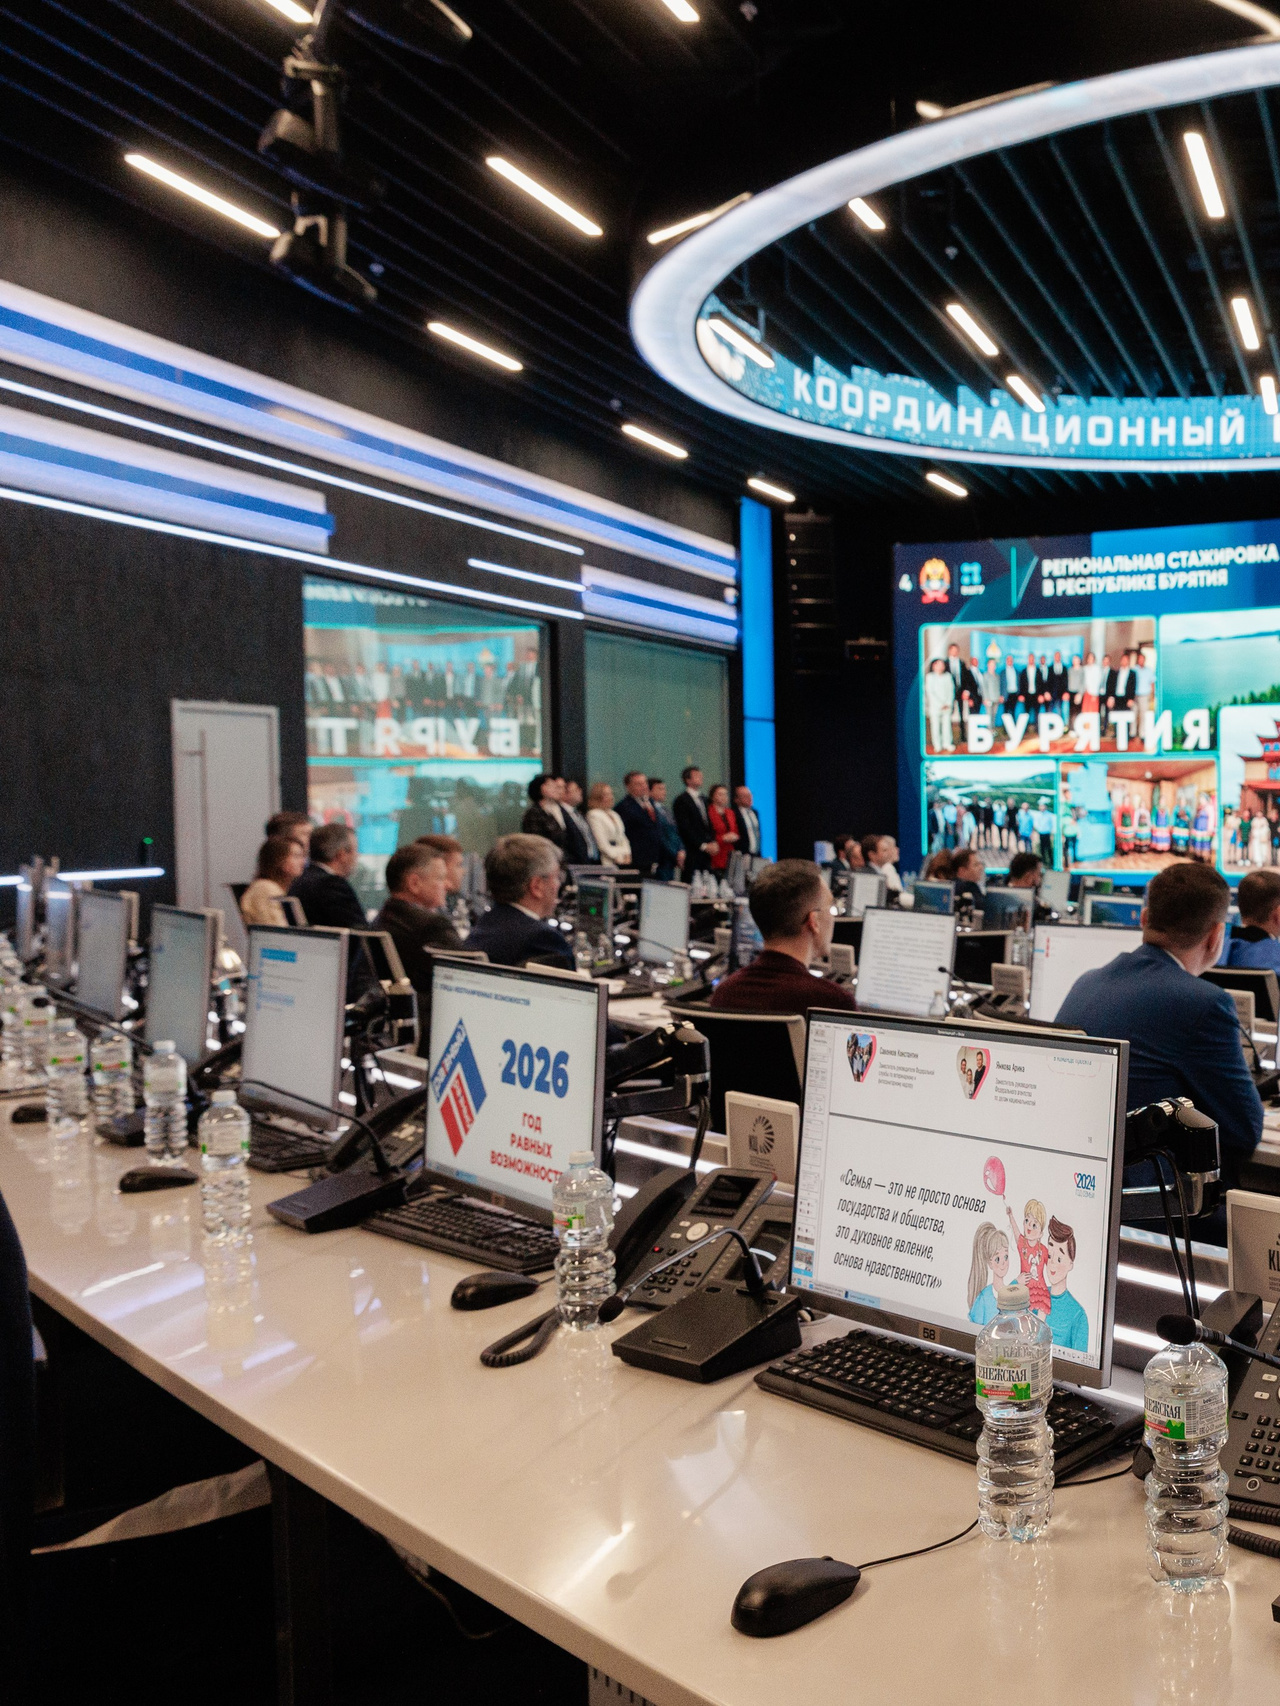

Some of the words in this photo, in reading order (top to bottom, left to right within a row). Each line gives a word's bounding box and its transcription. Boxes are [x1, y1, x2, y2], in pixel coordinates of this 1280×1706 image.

[792, 367, 1246, 447] КООРДИНАЦИОННЫЙ
[1042, 552, 1165, 577] РЕГИОНАЛЬНАЯ
[1167, 543, 1280, 569] СТАЖИРОВКА
[1042, 579, 1054, 597] В
[1056, 572, 1155, 596] РЕСПУБЛИКЕ
[1158, 568, 1228, 590] БУРЯТИЯ
[967, 708, 1212, 755] БУРЯТИЯ
[501, 1039, 569, 1098] 2026
[522, 1112, 542, 1133] ГОД
[510, 1133, 553, 1159] РАВНЫХ
[490, 1150, 563, 1183] ВОЗМОЖНОСТ
[1076, 1172, 1096, 1191] 2024
[840, 1168, 873, 1190] «Семья
[888, 1181, 904, 1196] это
[905, 1185, 917, 1199] не
[918, 1187, 950, 1206] просто
[952, 1194, 987, 1213] основа
[837, 1198, 890, 1221] государства
[891, 1210, 899, 1223] и
[900, 1208, 945, 1235] общества,
[835, 1225, 850, 1240] это
[850, 1229, 893, 1250] духовное
[893, 1239, 934, 1262] явление,
[833, 1251, 864, 1270] основа
[865, 1260, 942, 1289] нравственности»
[922, 1327, 936, 1341] 58
[977, 1365, 1027, 1382] ЕНЕЖСКАЯ
